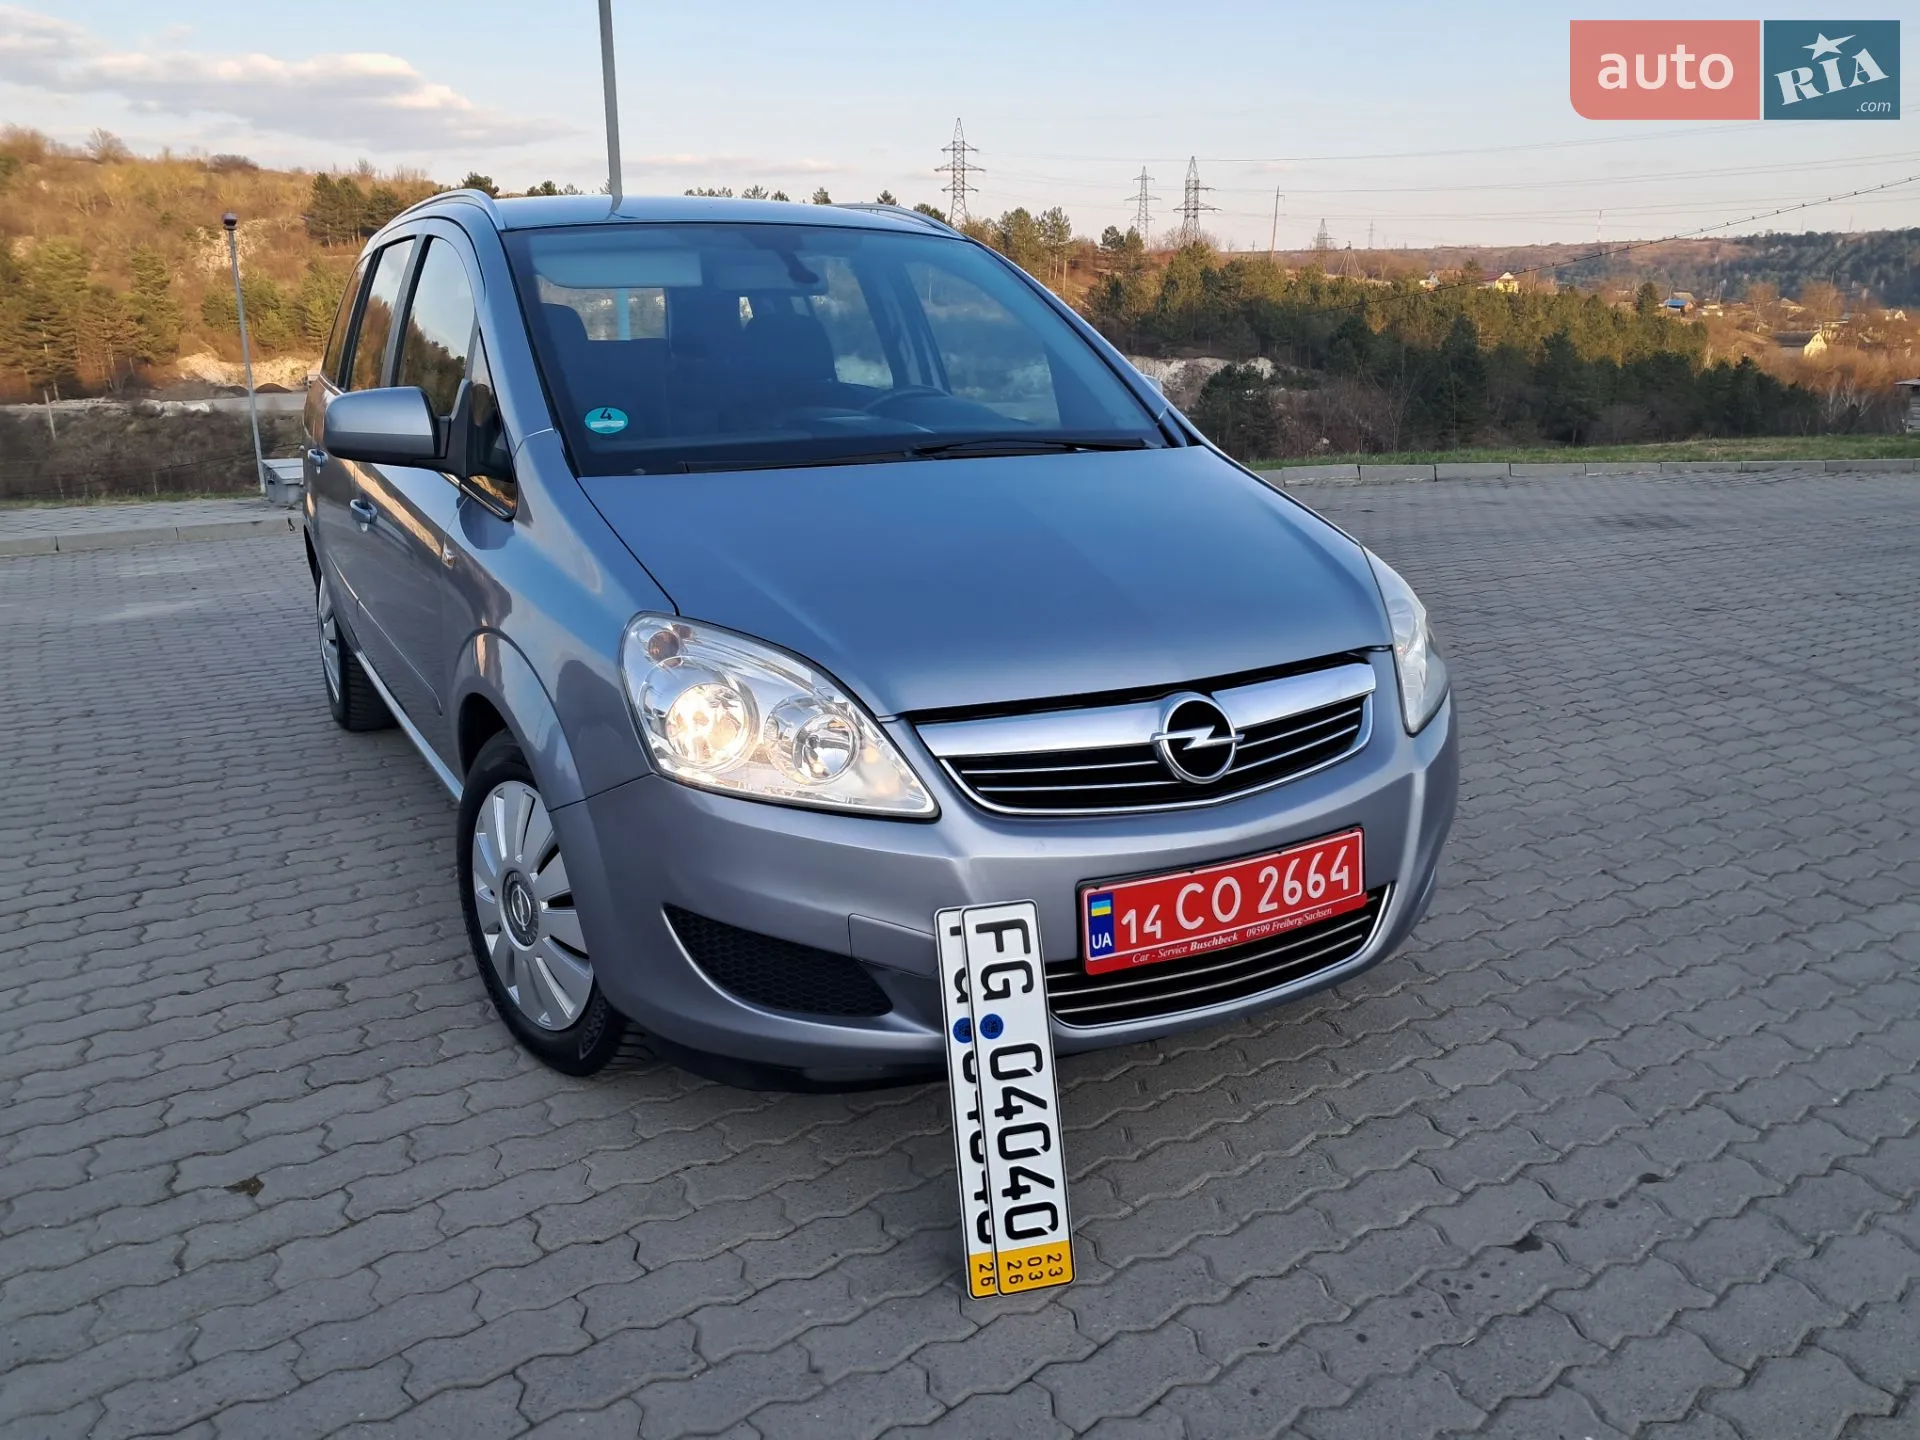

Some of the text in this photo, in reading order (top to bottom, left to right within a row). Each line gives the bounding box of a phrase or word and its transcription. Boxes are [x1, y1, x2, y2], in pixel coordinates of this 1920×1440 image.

[600, 408, 612, 420] 4
[1121, 845, 1349, 944] 14 CO 2664
[1092, 933, 1112, 950] UA
[1132, 953, 1149, 964] Car
[1158, 945, 1187, 958] Service
[1190, 931, 1238, 952] Buschbeck
[1246, 923, 1270, 938] 09599
[1303, 907, 1332, 922] Sachsen
[975, 918, 1034, 1001] FG
[989, 1043, 1059, 1240] 04040
[979, 1262, 995, 1287] 26
[1006, 1260, 1023, 1284] 26
[1027, 1256, 1043, 1281] 03
[1047, 1253, 1063, 1277] 23
